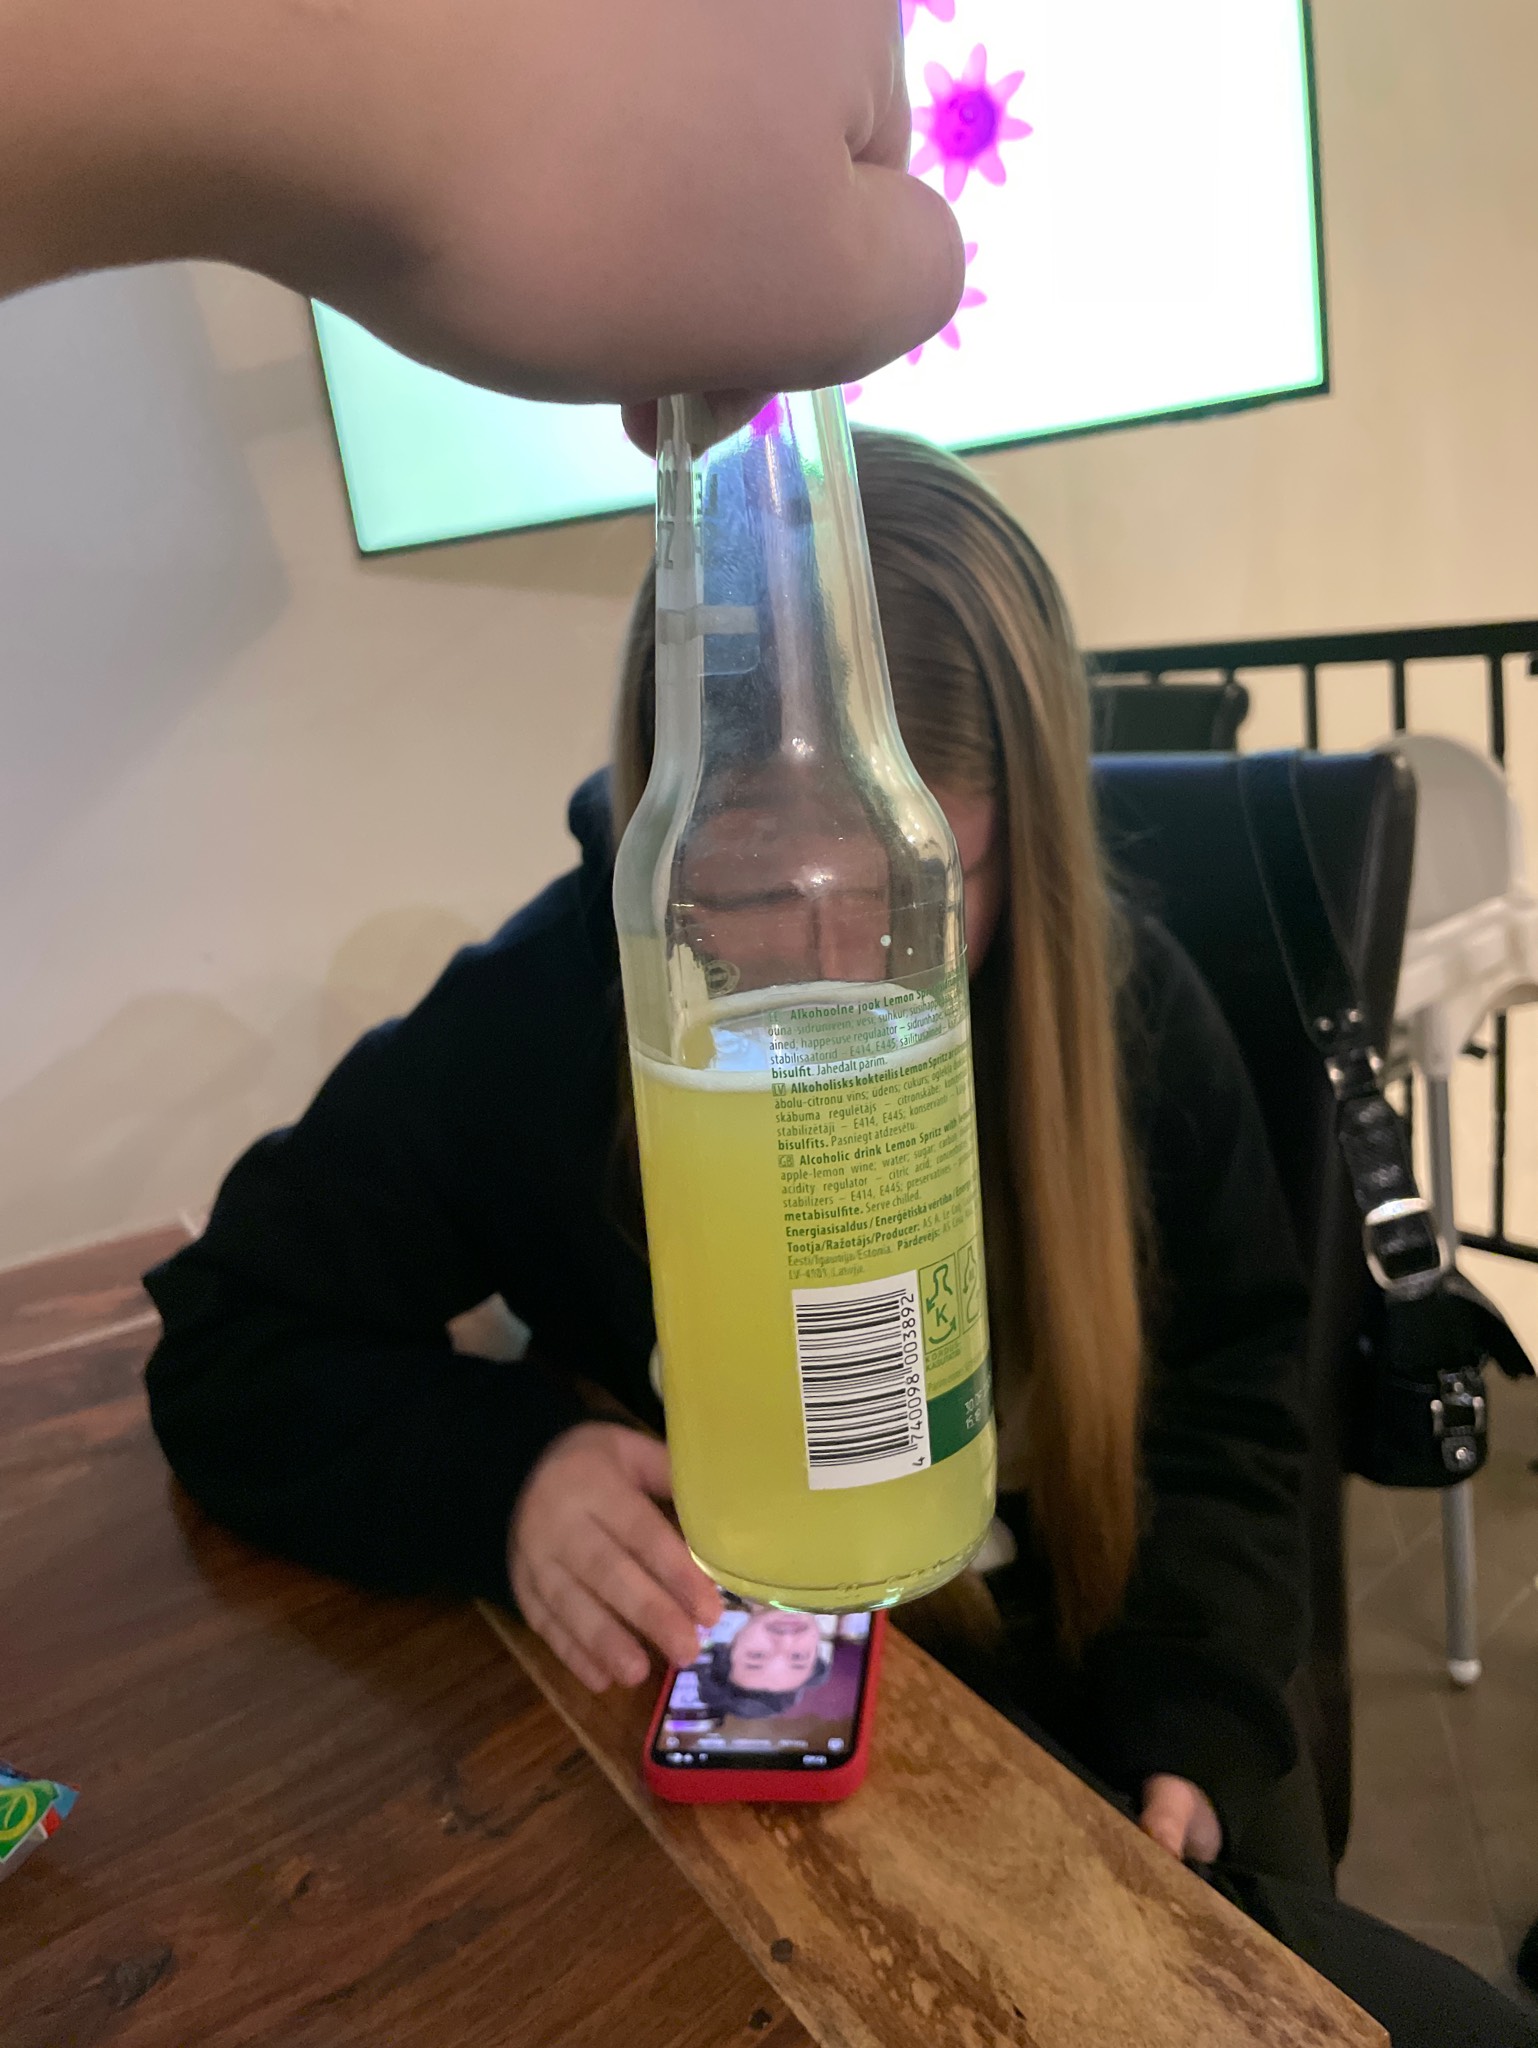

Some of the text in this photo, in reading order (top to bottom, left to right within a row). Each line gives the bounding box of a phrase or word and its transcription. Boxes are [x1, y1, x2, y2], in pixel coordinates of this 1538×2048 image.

[791, 1005, 854, 1021] Alkohoolne
[858, 998, 880, 1016] jook
[883, 992, 914, 1008] Lemon
[801, 1035, 851, 1052] happesuse
[853, 1025, 897, 1045] regulaator
[770, 1051, 838, 1065] stabilisaatorid
[772, 1056, 888, 1080] bisulfit. Jahedalt parim.
[772, 1082, 786, 1096] LV
[791, 1078, 854, 1095] Alkoholisks
[855, 1068, 898, 1086] kokteilis
[900, 1061, 928, 1078] Lemon
[928, 1053, 948, 1070] Spritz
[775, 1109, 820, 1124] skābuma
[778, 1134, 829, 1151] bisulfīts.
[831, 1129, 872, 1147] Pasniegt
[800, 1150, 849, 1167] Alcoholic
[854, 1144, 882, 1160] drink
[885, 1137, 917, 1154] Lemon
[919, 1127, 941, 1144] Spritz
[781, 1166, 844, 1182] apple-lemon
[781, 1181, 815, 1196] acidity
[823, 1175, 867, 1194] regulator
[888, 1165, 909, 1182] citric
[783, 1194, 834, 1209] stabilizers
[784, 1206, 864, 1222] metabisulfite.
[865, 1199, 890, 1214] Serve
[785, 1219, 868, 1239] Energiasisaldus
